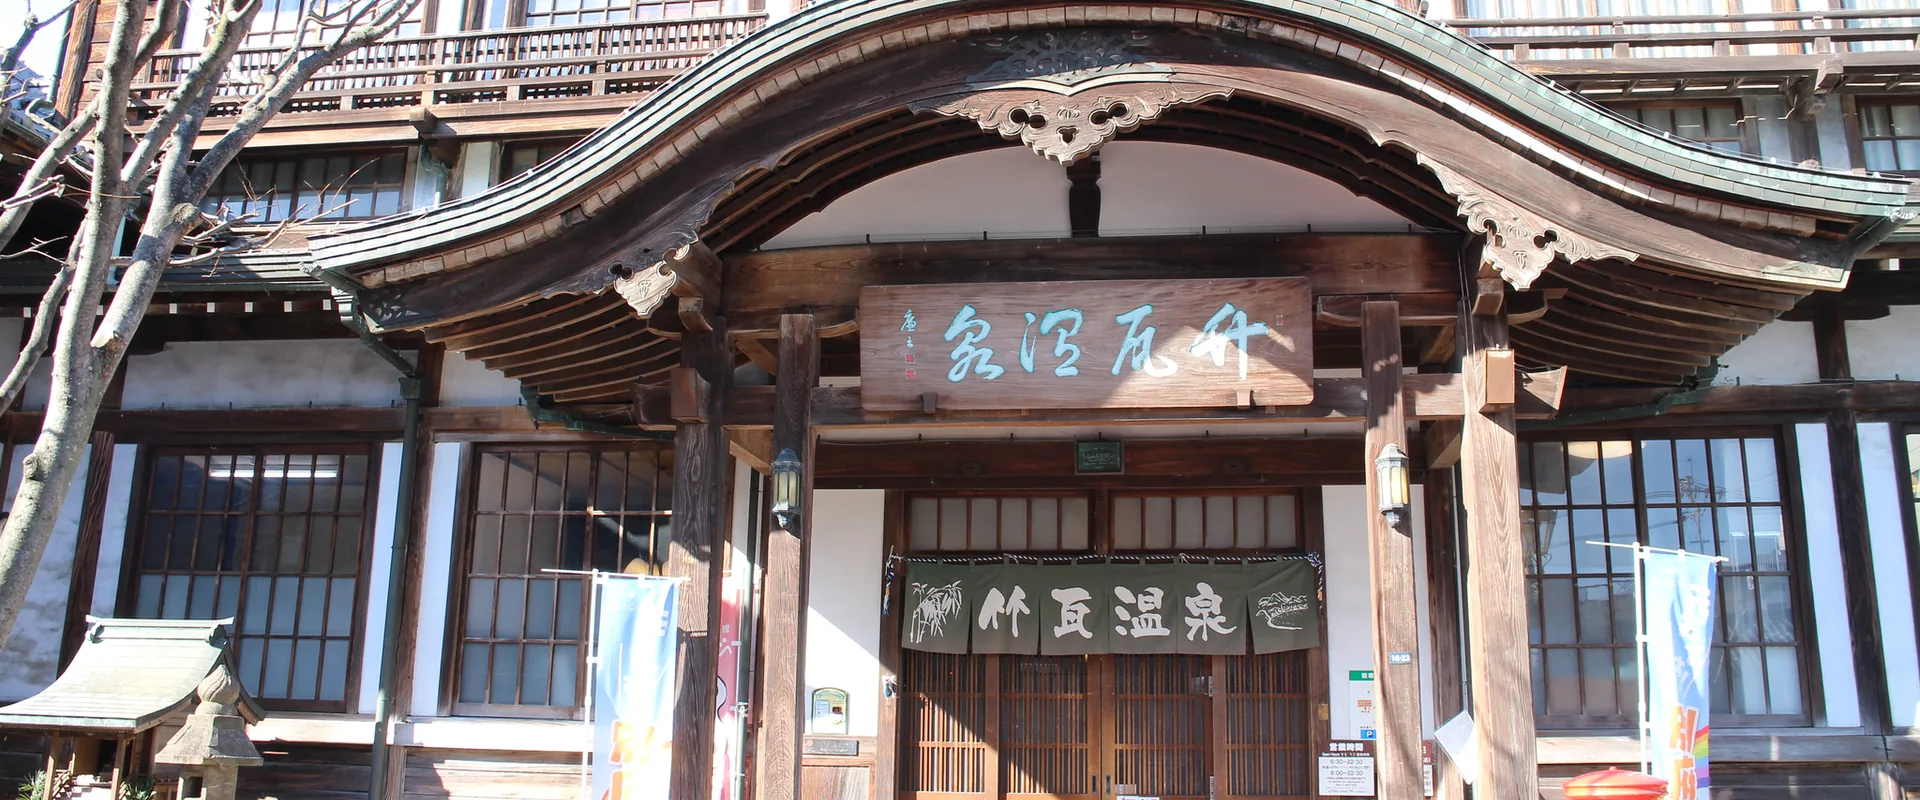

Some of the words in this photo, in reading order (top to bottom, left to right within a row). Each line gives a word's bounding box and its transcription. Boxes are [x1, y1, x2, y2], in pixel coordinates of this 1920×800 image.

[977, 582, 1237, 642] 竹瓦温泉
[1329, 742, 1364, 752] 営業時間
